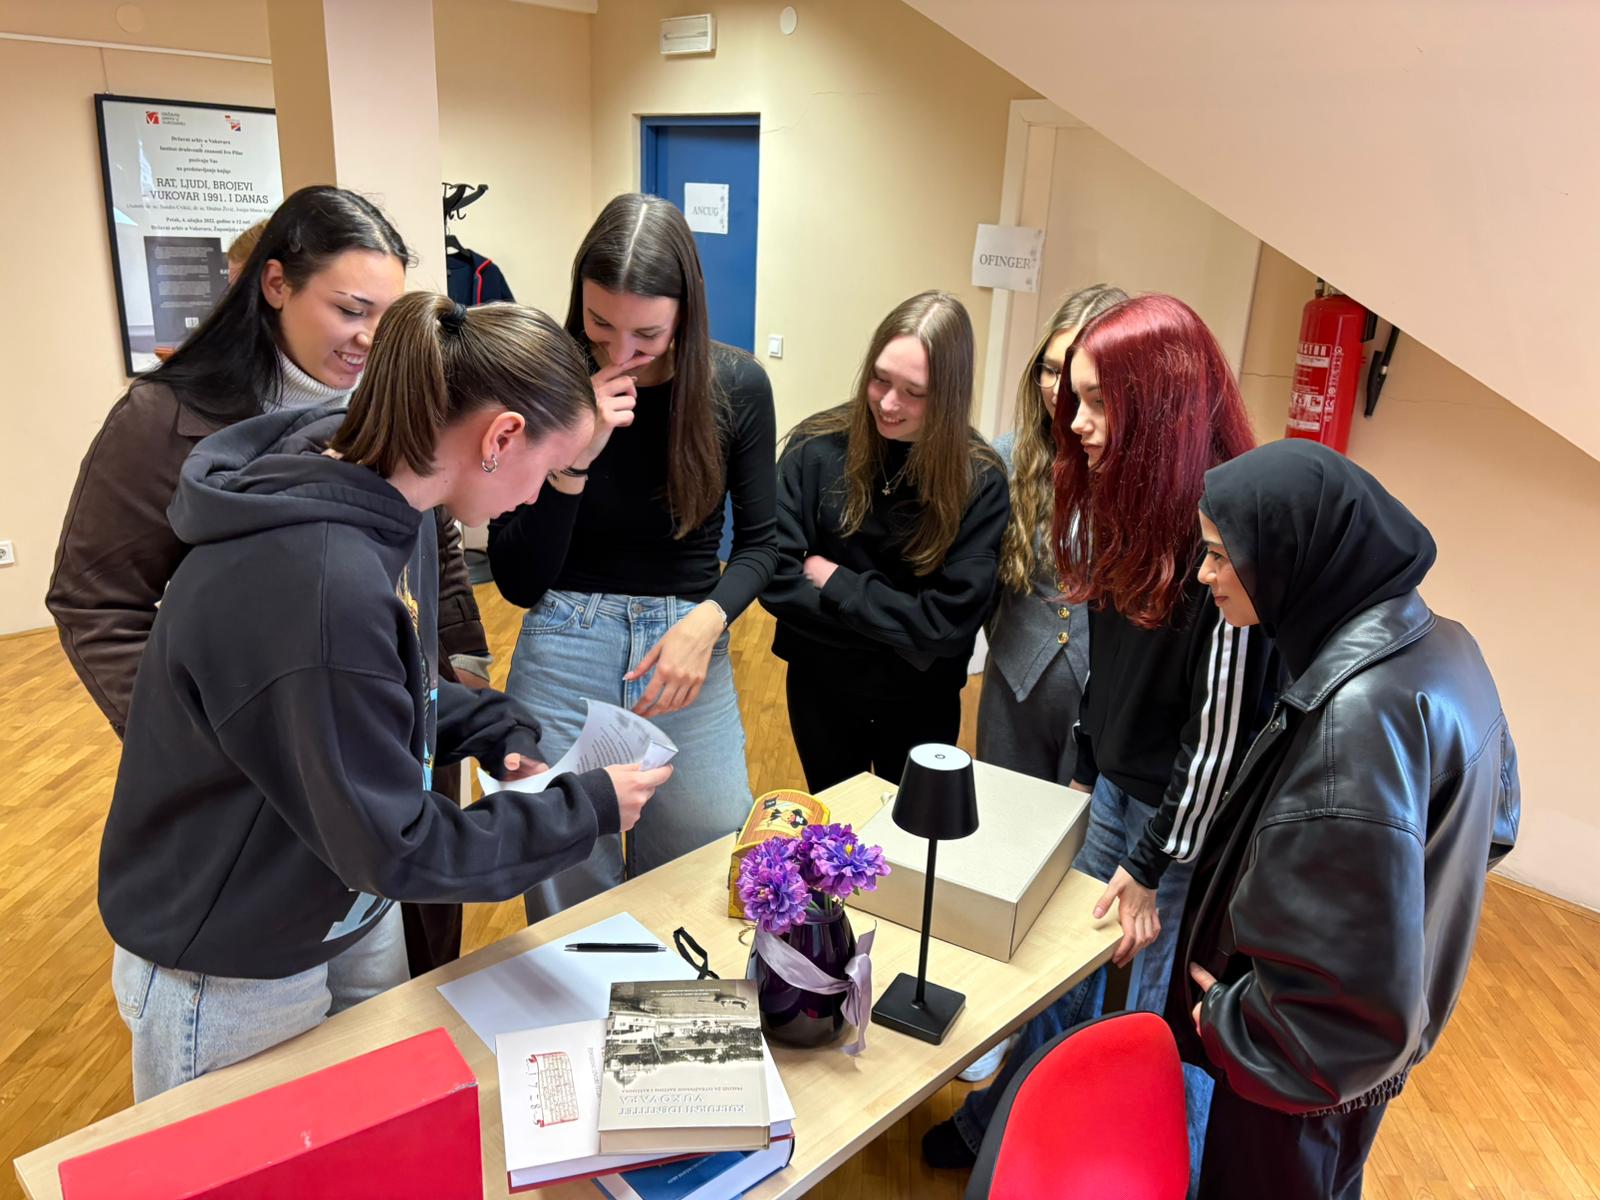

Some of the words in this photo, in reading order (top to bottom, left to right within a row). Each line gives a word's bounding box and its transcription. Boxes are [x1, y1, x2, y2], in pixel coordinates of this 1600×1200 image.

[156, 178, 178, 189] RAT,
[180, 179, 211, 190] LJUDI,
[213, 180, 253, 191] BROJEVI
[150, 190, 200, 201] VUKOVAR
[203, 192, 227, 202] 1991.
[229, 193, 233, 203] I
[234, 194, 269, 204] DANAS
[692, 205, 719, 217] ANCUG
[980, 253, 1031, 269] OFINGER
[619, 1094, 704, 1104] VUKOVARA
[618, 1106, 682, 1115] IDENTITET
[685, 1104, 745, 1112] KULTURNI
